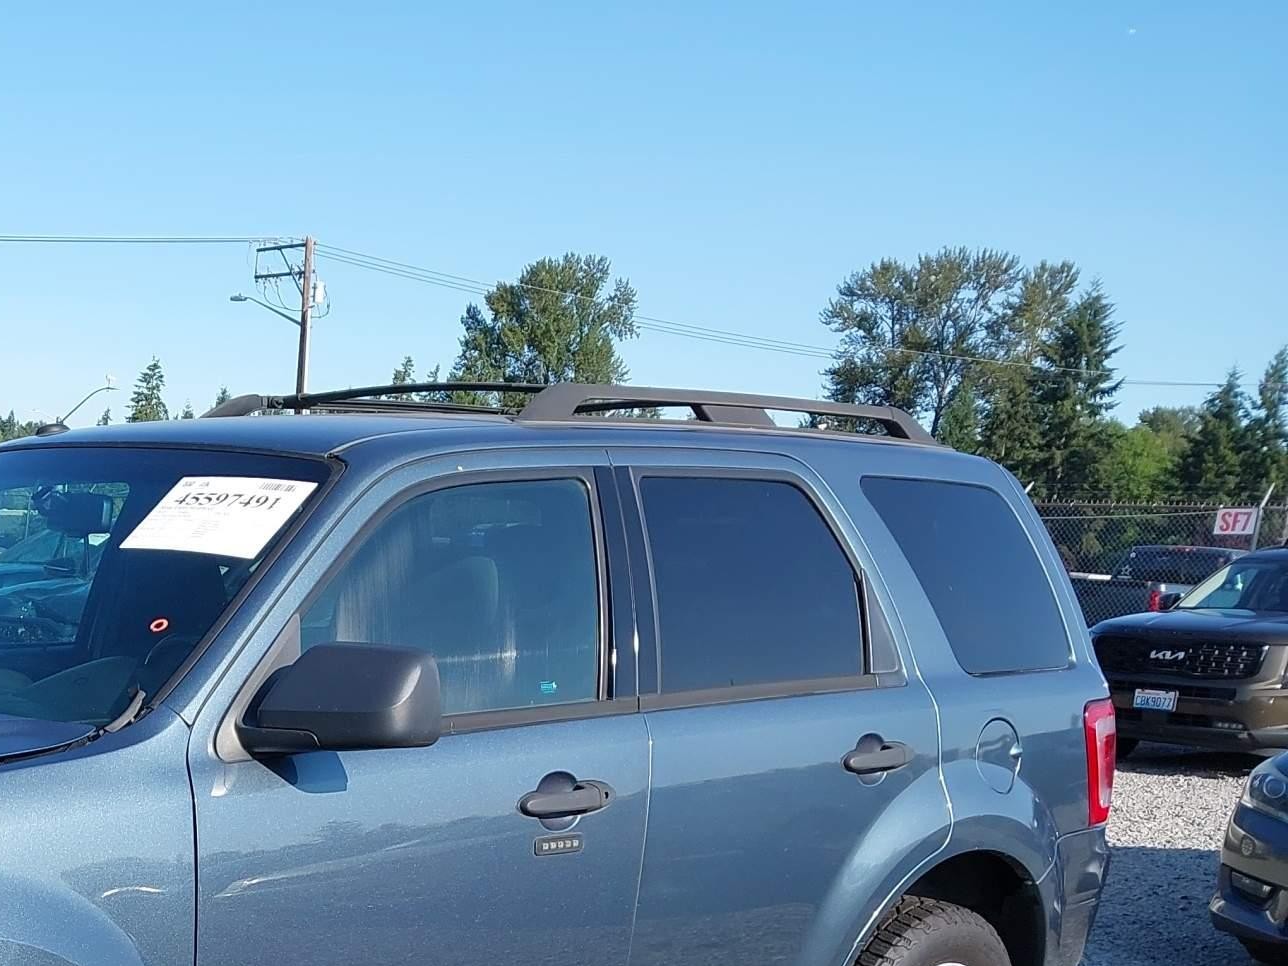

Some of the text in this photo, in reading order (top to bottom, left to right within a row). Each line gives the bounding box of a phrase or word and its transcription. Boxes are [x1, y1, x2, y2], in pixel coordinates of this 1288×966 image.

[174, 492, 282, 510] 45597491
[1219, 511, 1253, 532] SF7
[1135, 695, 1173, 709] CBK9077
